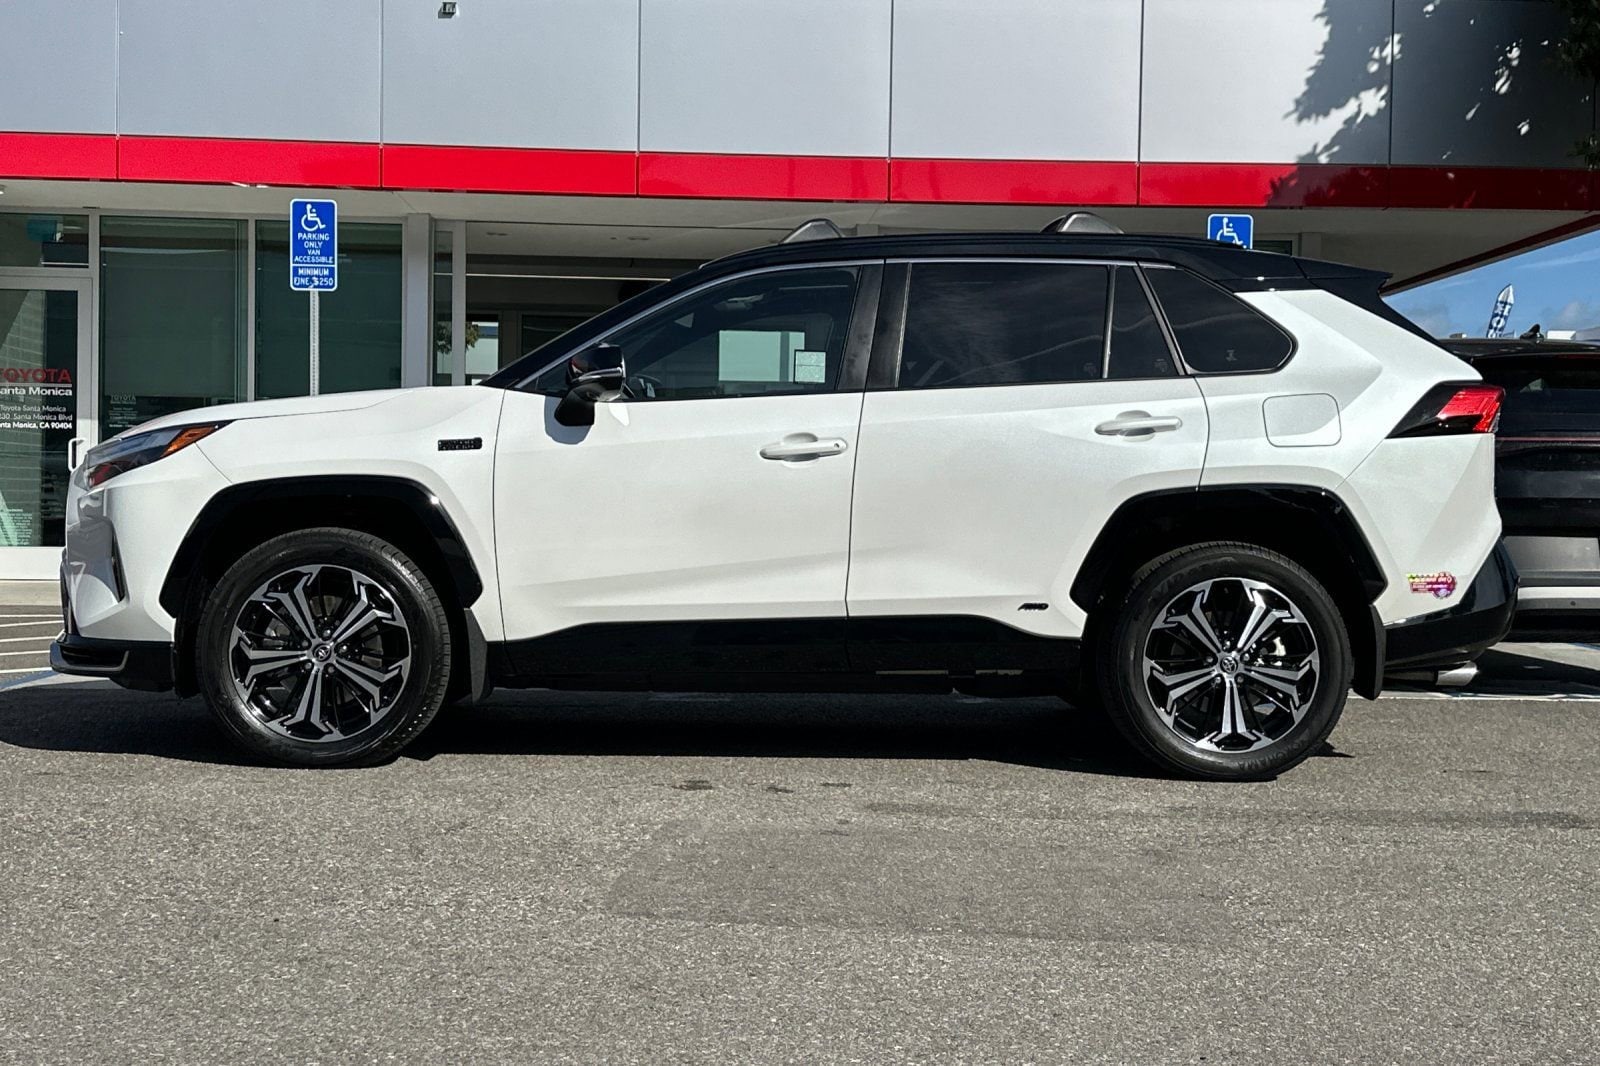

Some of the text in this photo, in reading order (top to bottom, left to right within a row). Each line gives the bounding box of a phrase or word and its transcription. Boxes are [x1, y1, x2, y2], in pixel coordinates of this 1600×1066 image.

[298, 232, 329, 240] PARKING
[0, 368, 72, 383] OYOTA
[29, 387, 72, 396] Monica
